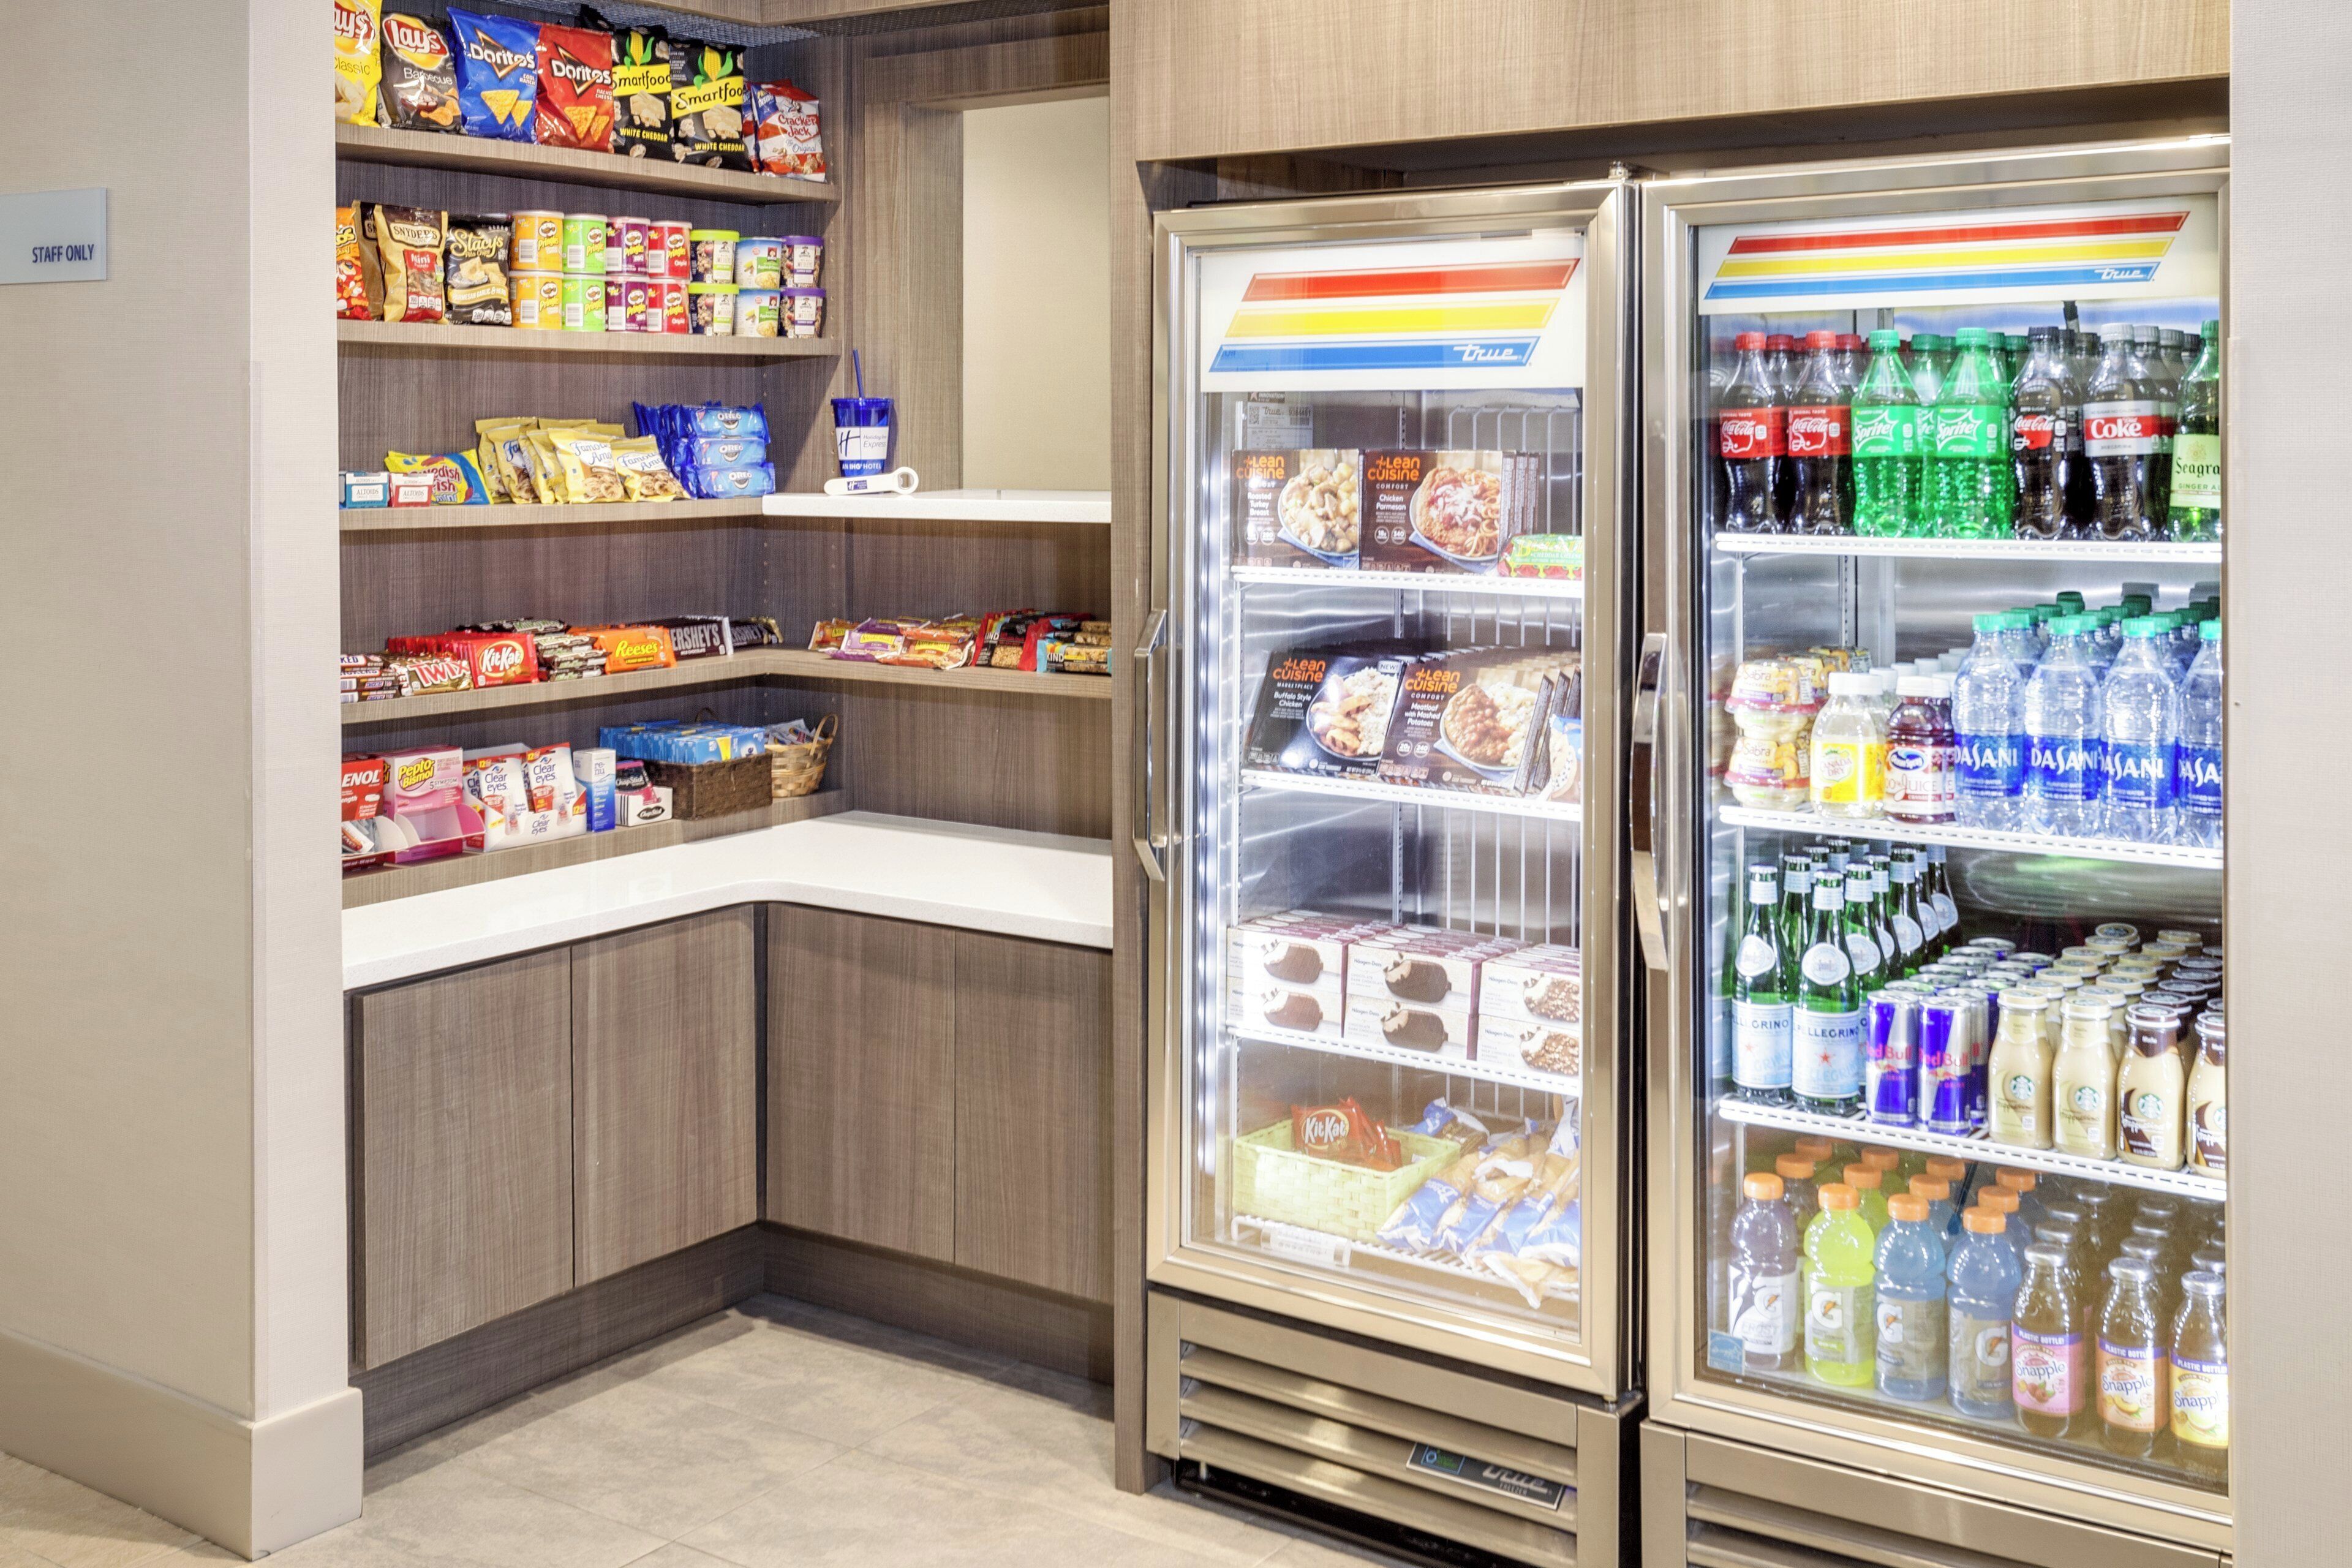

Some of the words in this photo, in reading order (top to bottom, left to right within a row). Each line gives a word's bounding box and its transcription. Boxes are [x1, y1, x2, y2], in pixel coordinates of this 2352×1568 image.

[390, 21, 442, 55] Lay's
[469, 43, 536, 69] Doritos
[404, 67, 453, 88] Barbecue
[552, 59, 611, 85] Doritos
[778, 115, 816, 127] Cracker
[620, 127, 641, 138] WHITE
[641, 130, 668, 143] CHEDDAR
[788, 126, 812, 138] Jack
[695, 142, 718, 151] WHITE
[718, 143, 745, 152] CHEDDAR
[792, 144, 816, 154] Original
[32, 246, 63, 263] STAFF
[66, 244, 95, 262] ONLY
[412, 252, 431, 265] Mini
[717, 412, 742, 421] OREO
[1855, 421, 1892, 440] Sprite
[1937, 421, 1975, 440] Sprite
[2090, 418, 2143, 439] Coke
[720, 445, 744, 454] OREO
[863, 440, 886, 449] Express
[729, 472, 753, 481] OREO
[435, 493, 457, 502] mini
[616, 639, 658, 657] Reese's
[1274, 691, 1297, 701] Buffalo
[1296, 693, 1313, 701] Style
[1279, 699, 1303, 708] Chicken
[1411, 703, 1439, 711] Meatloaf
[1407, 719, 1434, 728] Potatoes
[2031, 745, 2098, 775] DASANI
[533, 763, 556, 775] Clear
[402, 768, 434, 790] Bismol
[485, 773, 507, 784] Clear
[535, 773, 556, 785] eyes
[487, 783, 507, 794] eyes
[532, 819, 549, 828] Clear
[531, 827, 548, 835] eyes
[2016, 1360, 2066, 1381] Snapple
[2177, 1358, 2201, 1371] PLASTIC
[2101, 1374, 2153, 1396] Snapple
[1499, 1482, 1528, 1496] FREEZER
